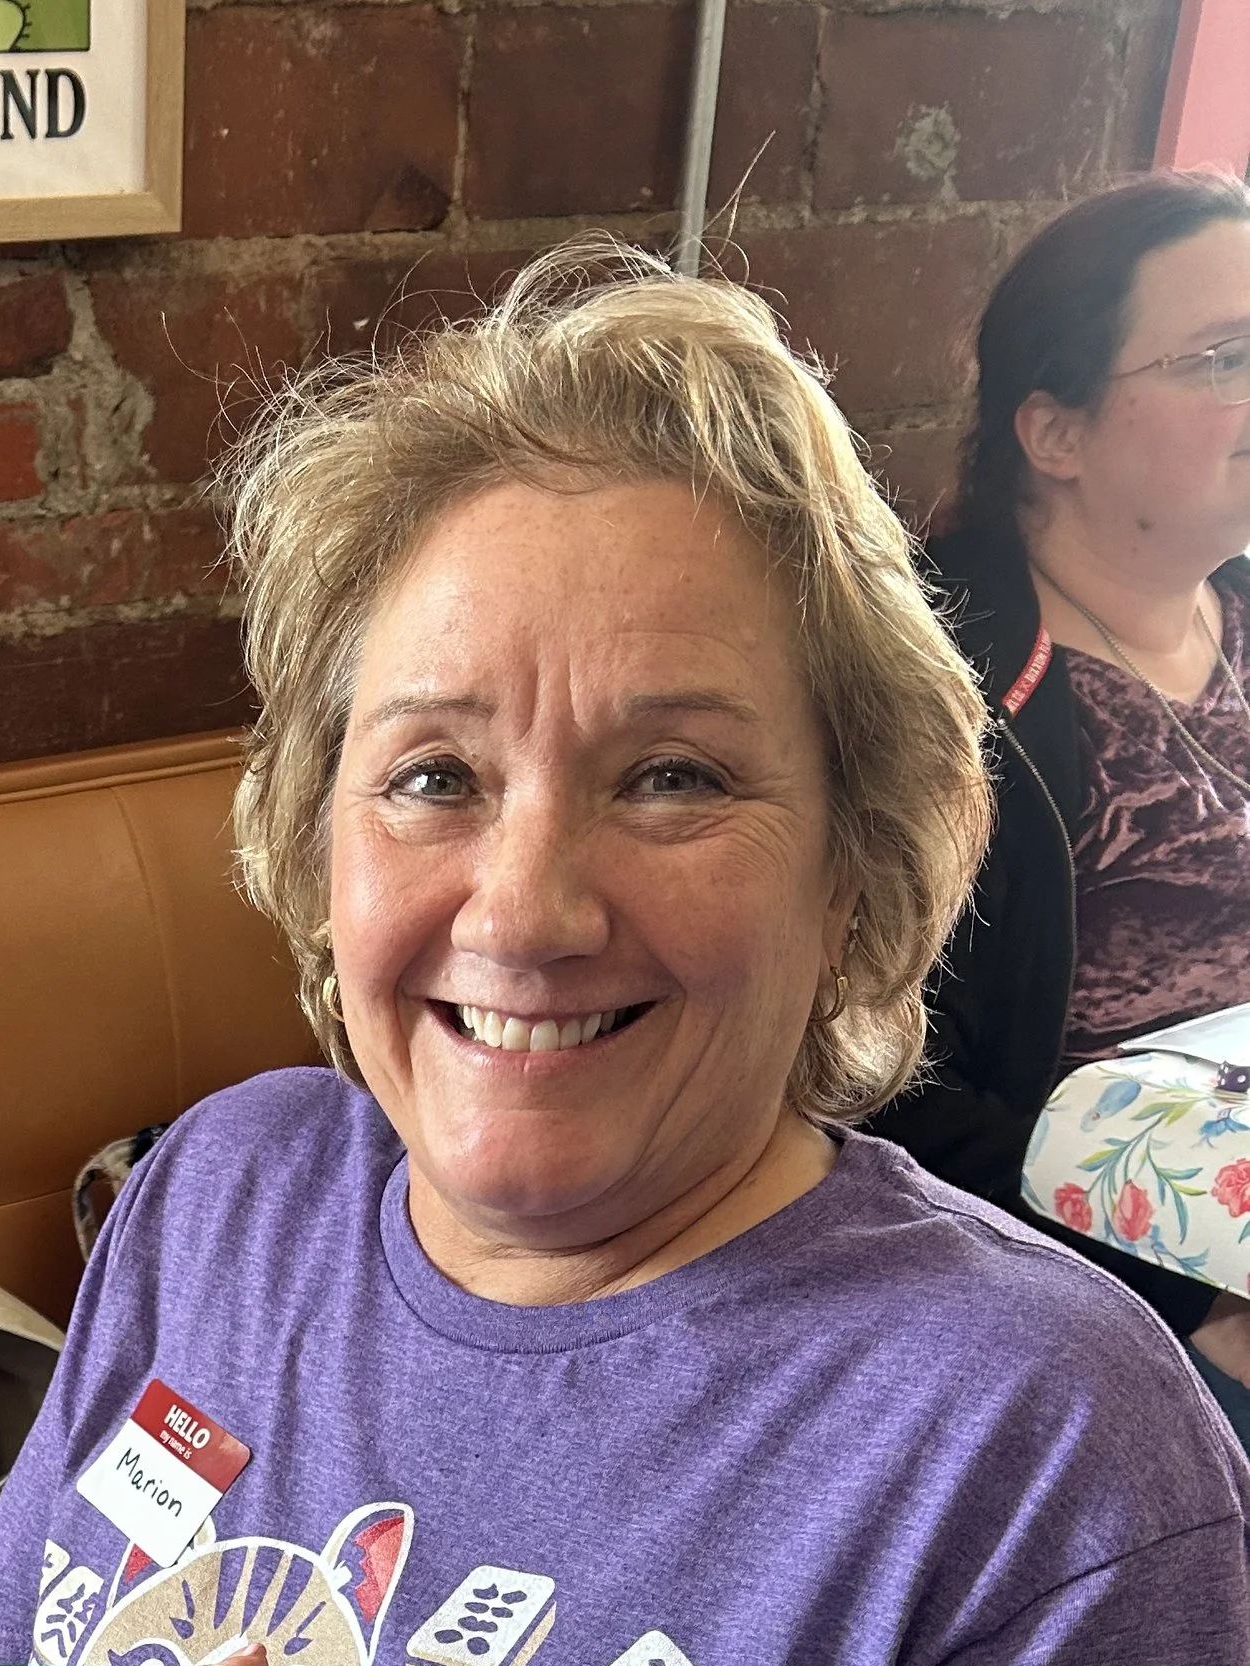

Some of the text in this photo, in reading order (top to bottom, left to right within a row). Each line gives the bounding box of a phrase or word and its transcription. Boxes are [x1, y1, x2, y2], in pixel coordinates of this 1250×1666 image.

[159, 1429, 193, 1460] my name is
[163, 1404, 211, 1450] HELLO
[116, 1447, 183, 1517] Marion
